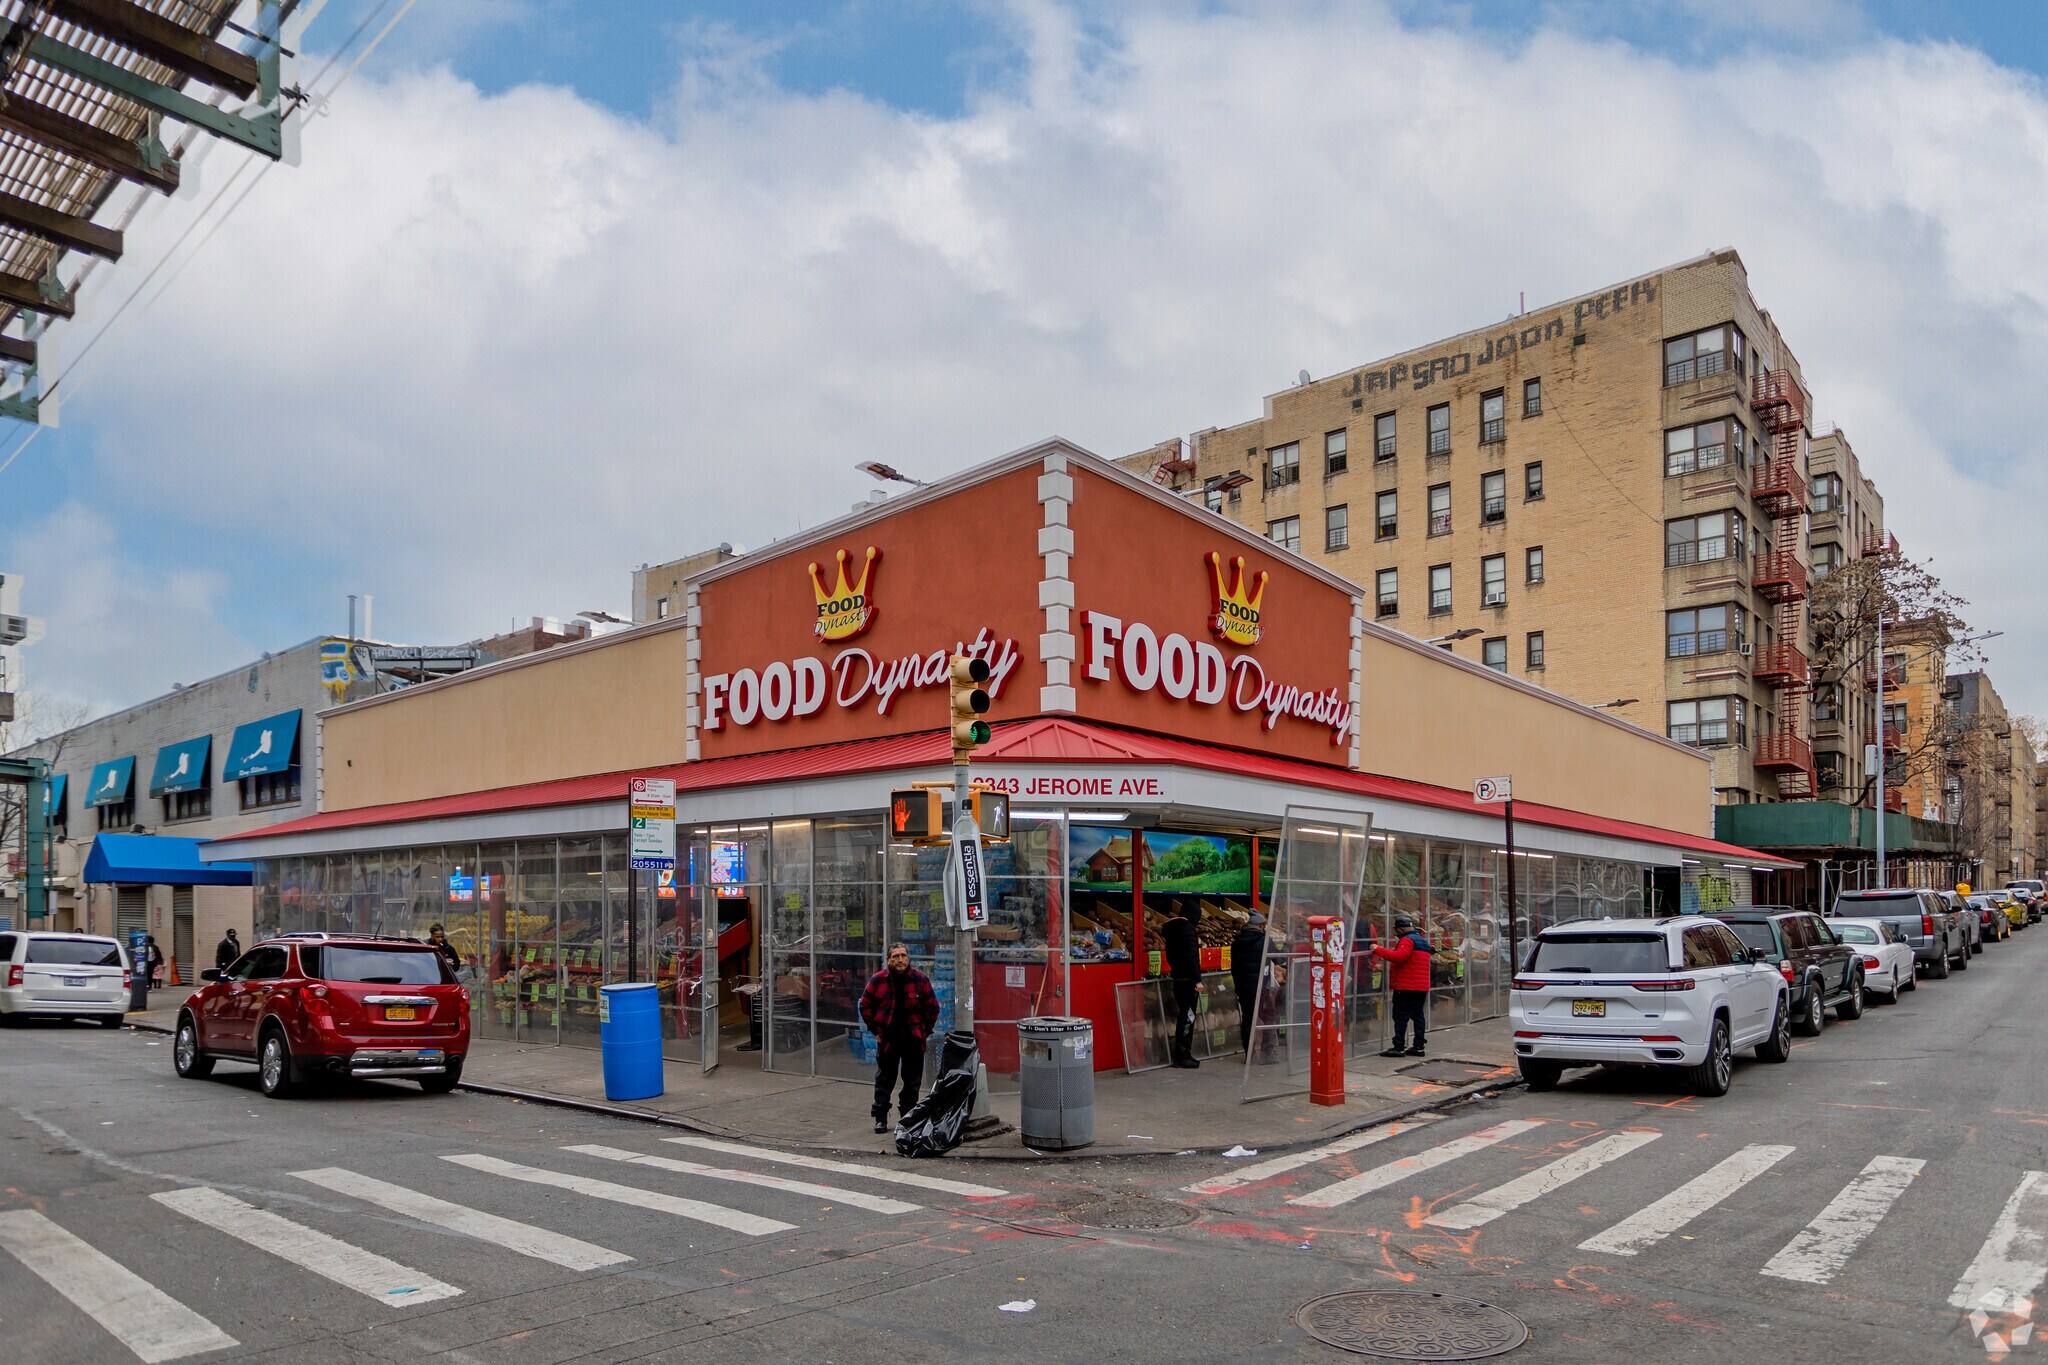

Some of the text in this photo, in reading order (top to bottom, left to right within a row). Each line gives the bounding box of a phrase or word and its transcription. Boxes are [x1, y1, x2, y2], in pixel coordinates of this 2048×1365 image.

[817, 594, 866, 618] FOOD
[1219, 598, 1260, 624] FOOD
[813, 606, 873, 643] Dynasty
[1216, 614, 1265, 645] Dynasty
[1087, 610, 1352, 746] FOOD Dynasty
[703, 656, 829, 731] FOOD
[1026, 777, 1113, 796] JEROME
[1118, 778, 1165, 796] AVE.
[635, 818, 643, 828] 2
[633, 860, 663, 869] 205511
[963, 845, 977, 898] essentia
